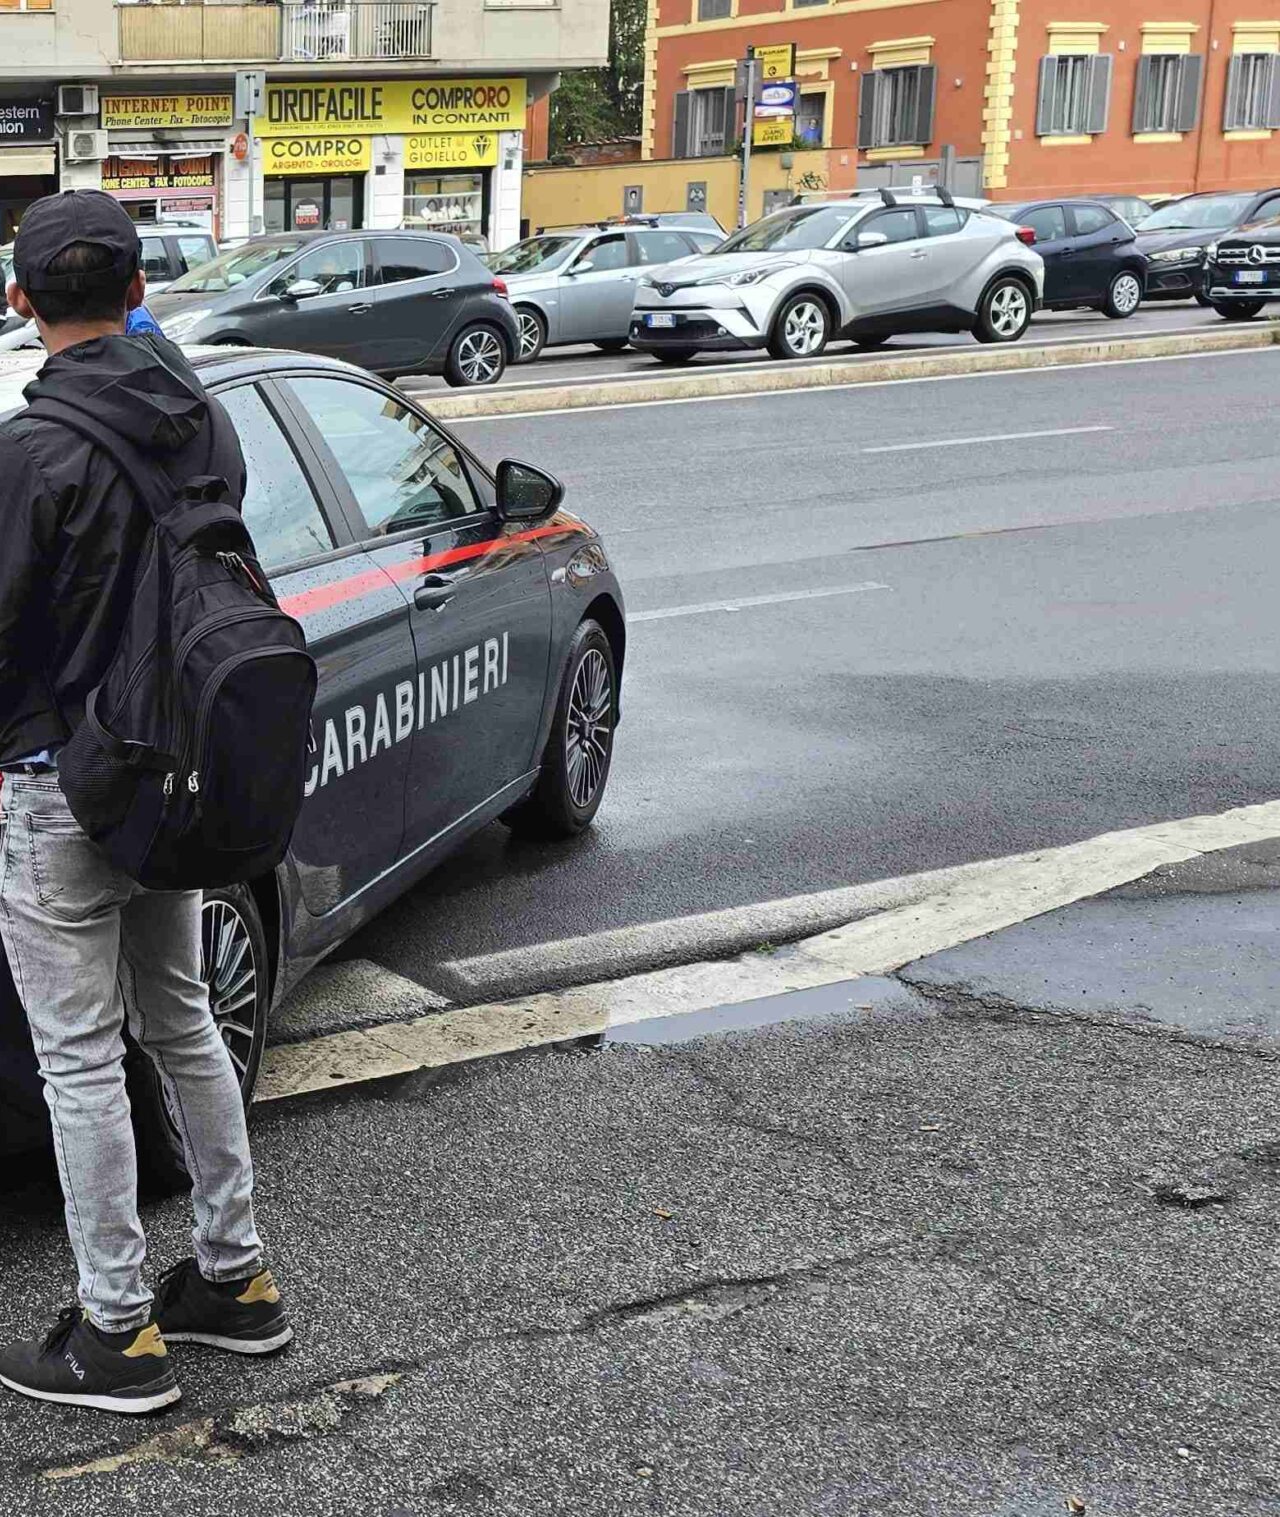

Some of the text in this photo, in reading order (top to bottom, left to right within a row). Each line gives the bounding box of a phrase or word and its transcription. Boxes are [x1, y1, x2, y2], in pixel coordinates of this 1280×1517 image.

[104, 96, 230, 114] INTERNET POINT
[268, 87, 383, 122] OROFACILE
[412, 86, 510, 110] COMPRORO
[105, 116, 132, 127] Phone
[134, 114, 163, 125] Center
[169, 114, 183, 125] Fax
[190, 113, 231, 125] Fotocopie
[413, 112, 509, 125] IN CONTANTI
[271, 139, 363, 158] COMPRO
[409, 137, 452, 150] OUTLET
[272, 160, 314, 170] ARGENTO
[320, 158, 362, 169] OROLOGI
[409, 150, 468, 163] GIOIELLO
[102, 158, 164, 177] NTERNET
[102, 178, 120, 190] HONE
[121, 176, 151, 189] CENTER
[155, 176, 169, 188] FAX
[174, 174, 214, 188] FOTOCOPIE
[65, 1351, 85, 1380] FILA
